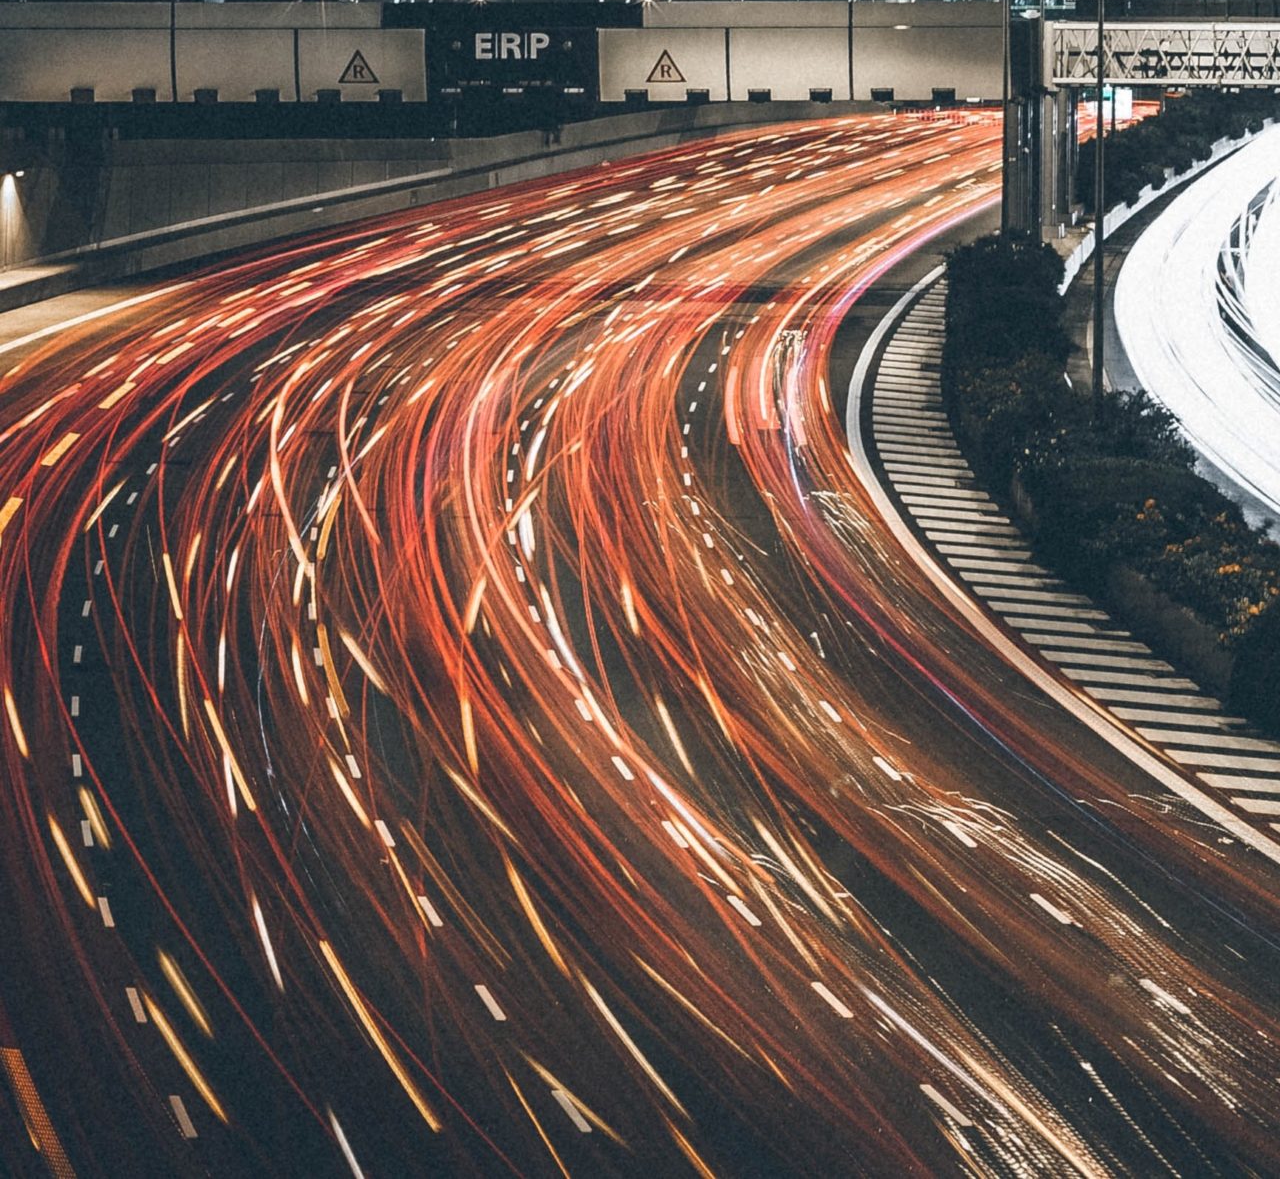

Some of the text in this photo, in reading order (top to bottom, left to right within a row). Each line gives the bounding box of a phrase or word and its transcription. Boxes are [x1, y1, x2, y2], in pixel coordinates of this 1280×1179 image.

[474, 32, 550, 60] ERP
[353, 64, 366, 79] R
[660, 64, 672, 78] R
